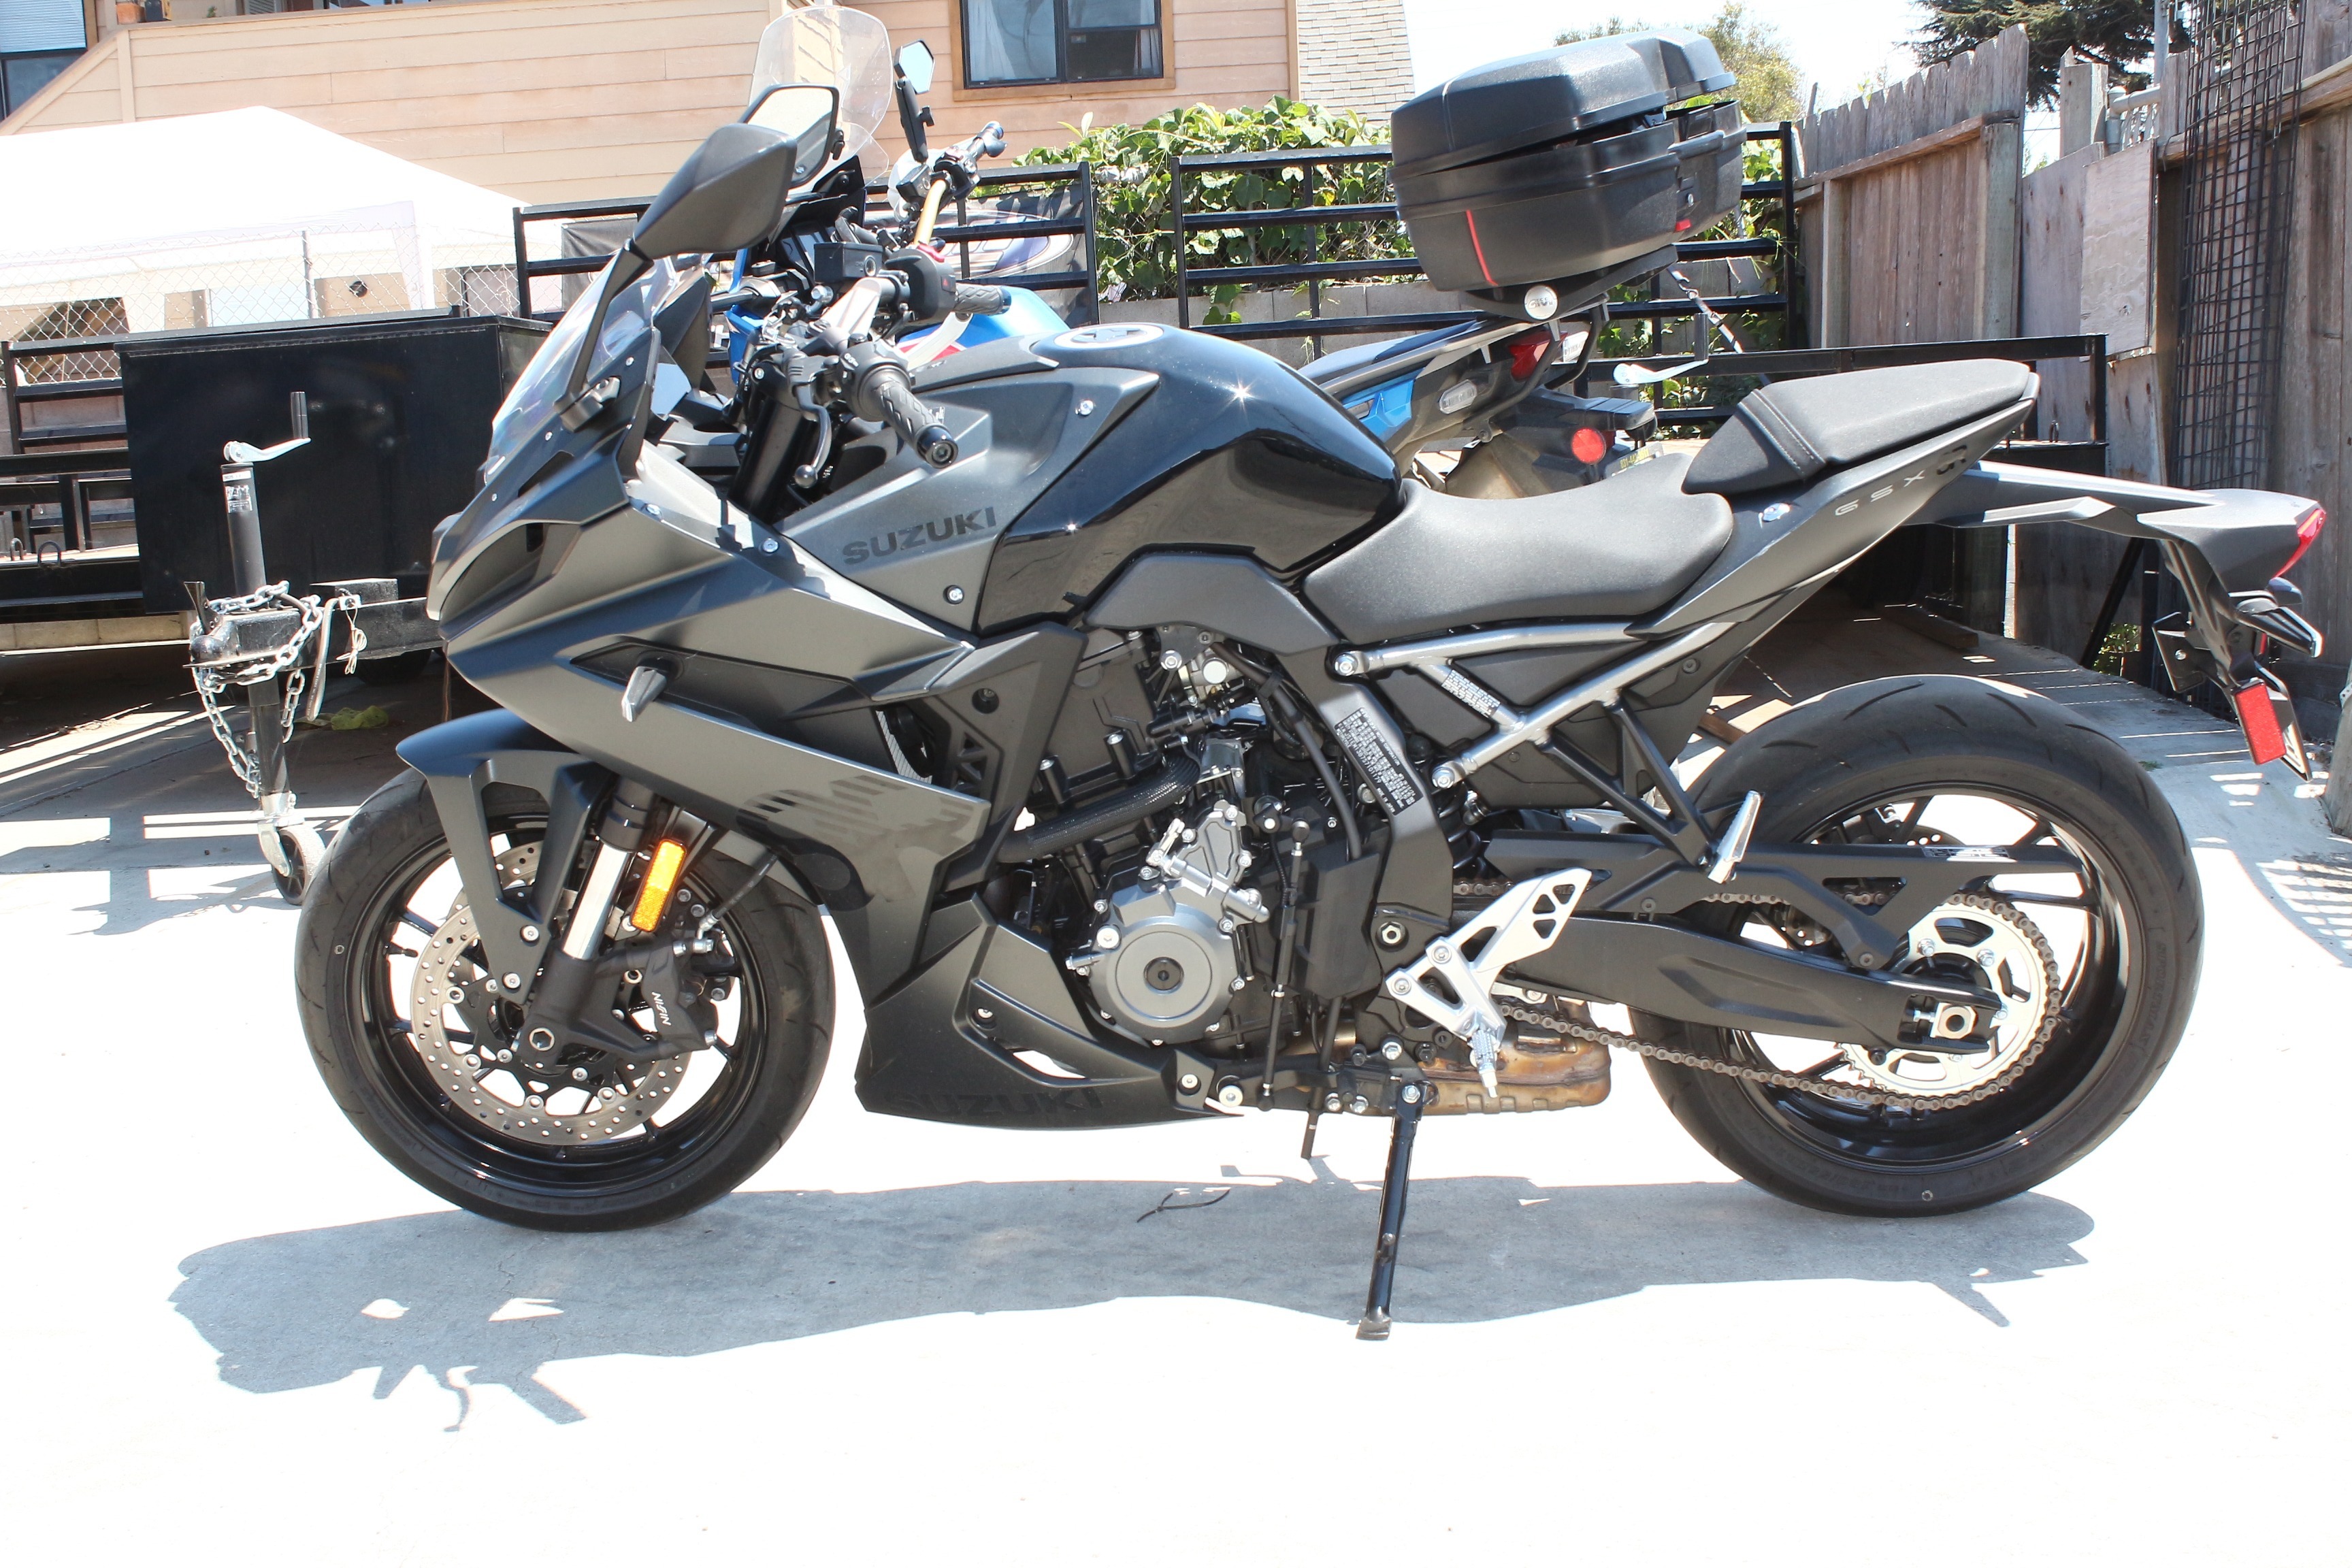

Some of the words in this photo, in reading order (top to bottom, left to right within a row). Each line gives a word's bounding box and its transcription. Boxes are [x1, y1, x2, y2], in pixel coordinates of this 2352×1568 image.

[1835, 470, 1925, 517] GSX
[842, 506, 997, 565] SUZUKI
[1383, 743, 1401, 766] CORPORATION
[883, 1087, 1103, 1115] SUZUKI
